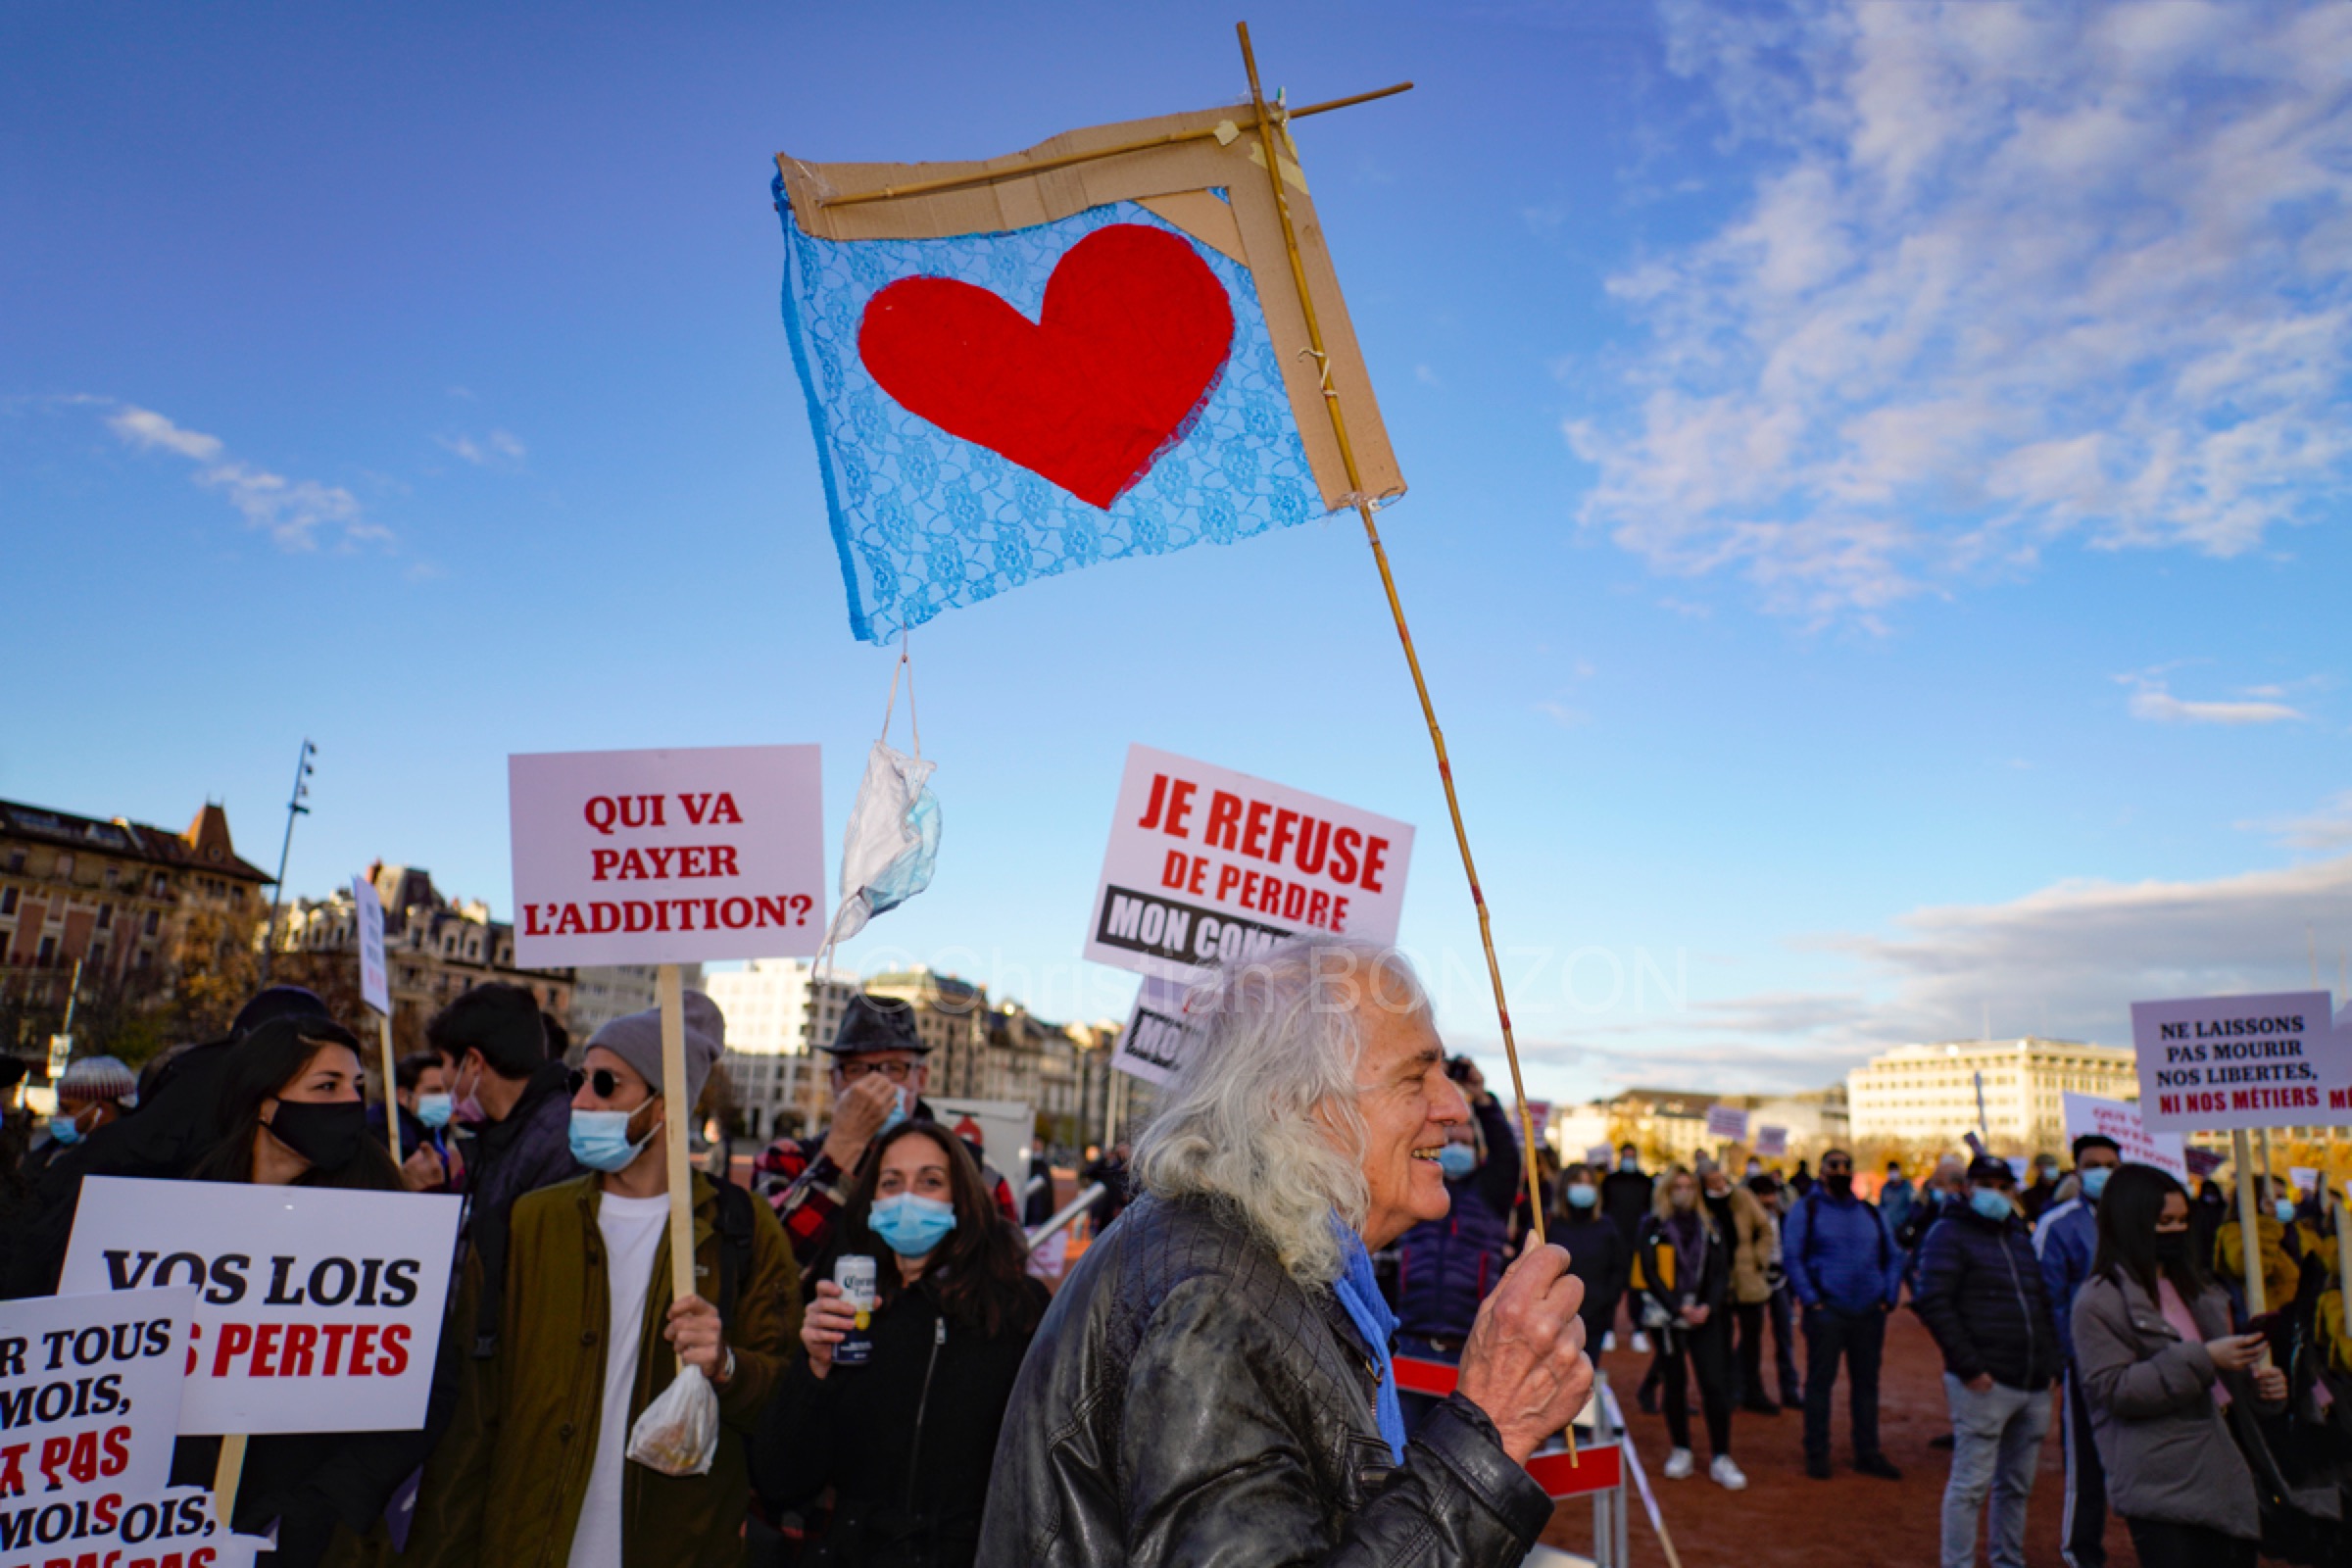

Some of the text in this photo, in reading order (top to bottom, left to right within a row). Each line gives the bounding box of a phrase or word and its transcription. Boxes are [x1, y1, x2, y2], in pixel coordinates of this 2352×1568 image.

[584, 792, 743, 835] QUI VA
[1138, 772, 1391, 895] JE REFUSE
[591, 845, 740, 881] PAYER
[522, 893, 813, 937] L’ADDITION?
[1161, 849, 1350, 934] DE PERDRE
[1106, 893, 1284, 963] MON COM
[2160, 1015, 2306, 1041] NE LAISSONS
[2166, 1039, 2303, 1063] PAS MOURIR
[2156, 1067, 2202, 1088] NOS
[2159, 1085, 2320, 1114] NI NOS MÉTIERS
[103, 1249, 421, 1307] VOS LOIS
[41, 1318, 172, 1371] TOUS
[211, 1323, 413, 1378] PERTES
[0, 1374, 132, 1431] MOIS,
